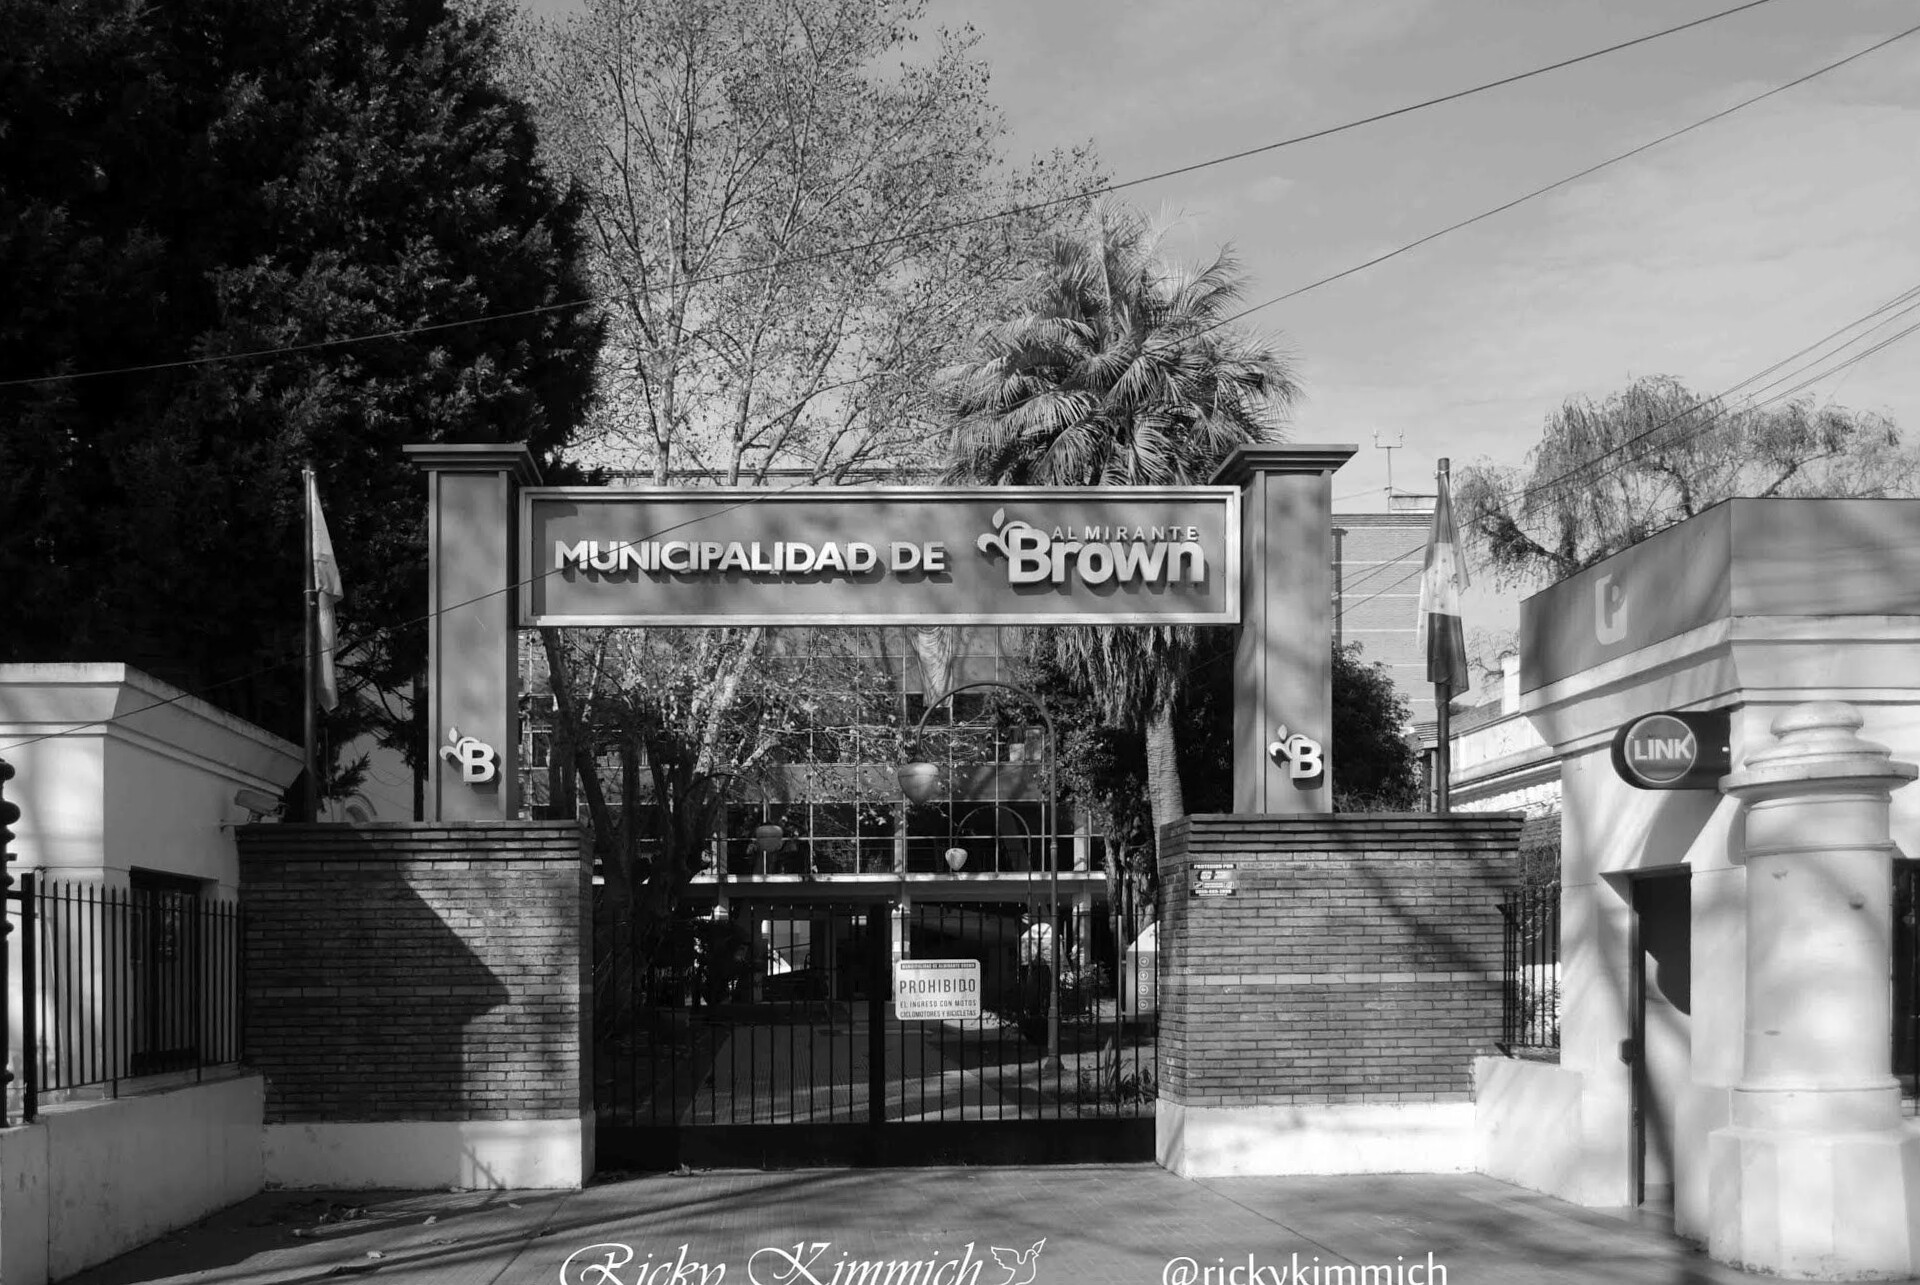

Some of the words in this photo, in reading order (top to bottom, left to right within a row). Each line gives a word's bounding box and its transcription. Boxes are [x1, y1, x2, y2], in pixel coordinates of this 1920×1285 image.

[1051, 525, 1199, 541] ALMIRANTE
[554, 540, 878, 574] MUNICIPALIDAD
[889, 540, 946, 573] DE
[1008, 528, 1205, 584] Brown
[1634, 730, 1693, 761] LINK
[899, 978, 976, 994] PROHIBIDO
[909, 1000, 938, 1008] INGRESO
[954, 999, 976, 1007] MOTOS
[900, 1010, 940, 1018] CICLOMOTORES
